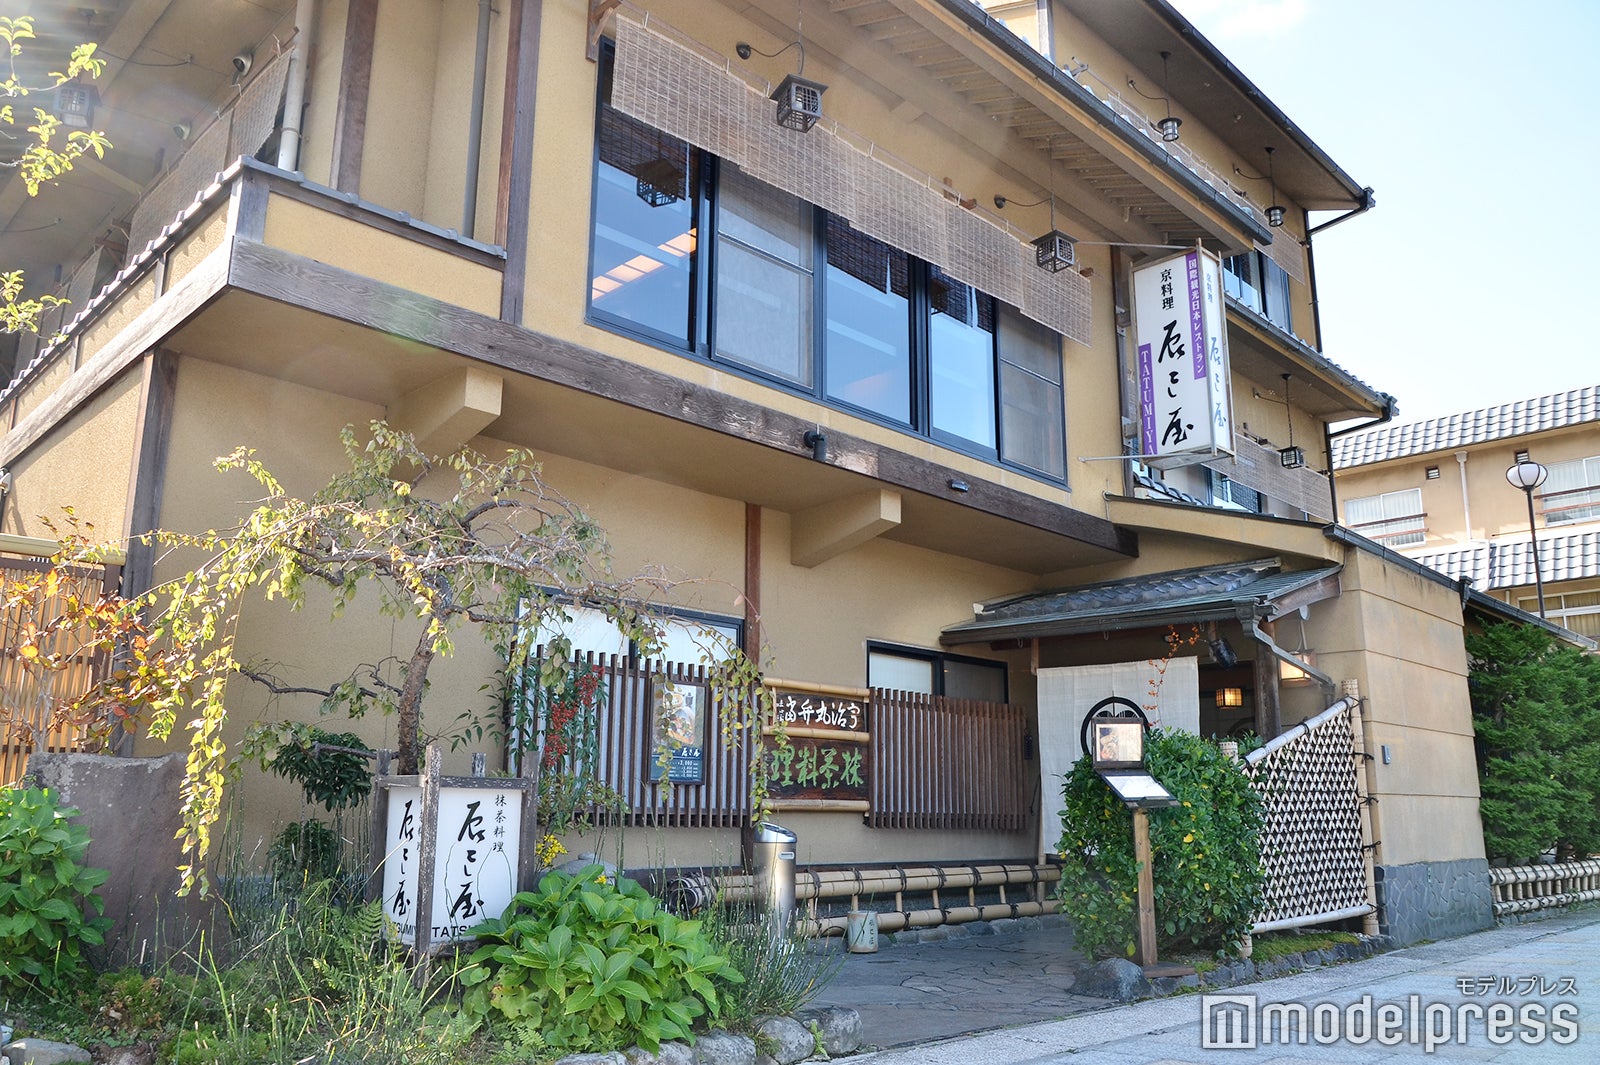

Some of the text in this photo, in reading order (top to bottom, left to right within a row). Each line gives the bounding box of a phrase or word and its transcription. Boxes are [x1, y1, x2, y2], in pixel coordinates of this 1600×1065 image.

[1160, 268, 1175, 311] 京料理
[1141, 350, 1155, 455] TATUMIYA
[492, 793, 507, 852] 抹茶料理
[431, 924, 471, 938] TATS
